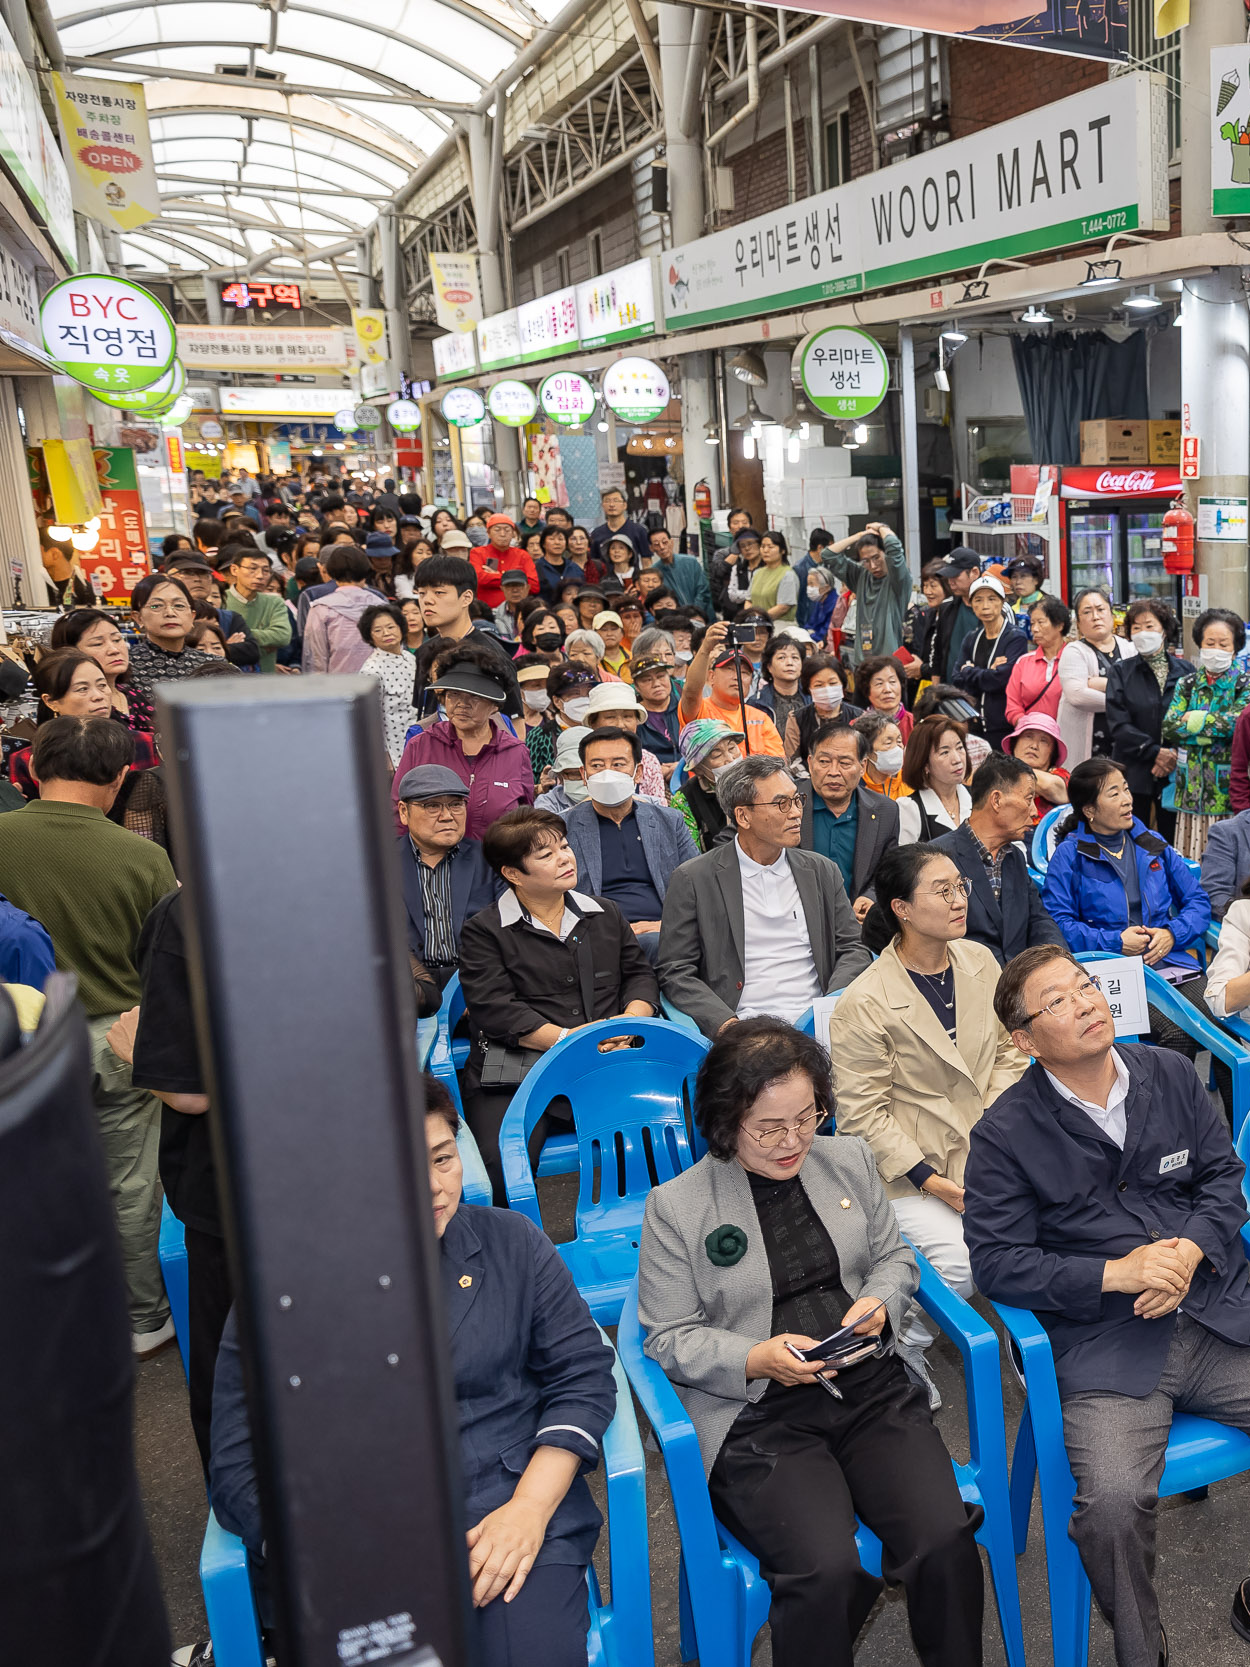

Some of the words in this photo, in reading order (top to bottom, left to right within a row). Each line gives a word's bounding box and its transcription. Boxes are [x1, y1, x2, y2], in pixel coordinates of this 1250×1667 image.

[65, 90, 137, 111] 자양전통시장
[86, 111, 121, 126] 주차장
[76, 127, 136, 145] 배송콜센터
[88, 152, 135, 169] OPEN
[733, 202, 843, 287] 우리마트생선
[871, 163, 976, 246] WOORI
[997, 114, 1111, 213] MART
[1081, 211, 1127, 236] T.444-0772
[222, 283, 301, 309] 4구역
[69, 293, 138, 320] BYC
[59, 325, 157, 359] 직영점
[812, 348, 876, 366] 우리마트
[93, 367, 131, 384] 속옷
[829, 371, 861, 389] 생선
[555, 379, 582, 392] 이불
[546, 390, 553, 400] &
[557, 397, 584, 410] 잡화
[837, 399, 857, 411] 생선
[1096, 470, 1157, 492] Coca-Cola
